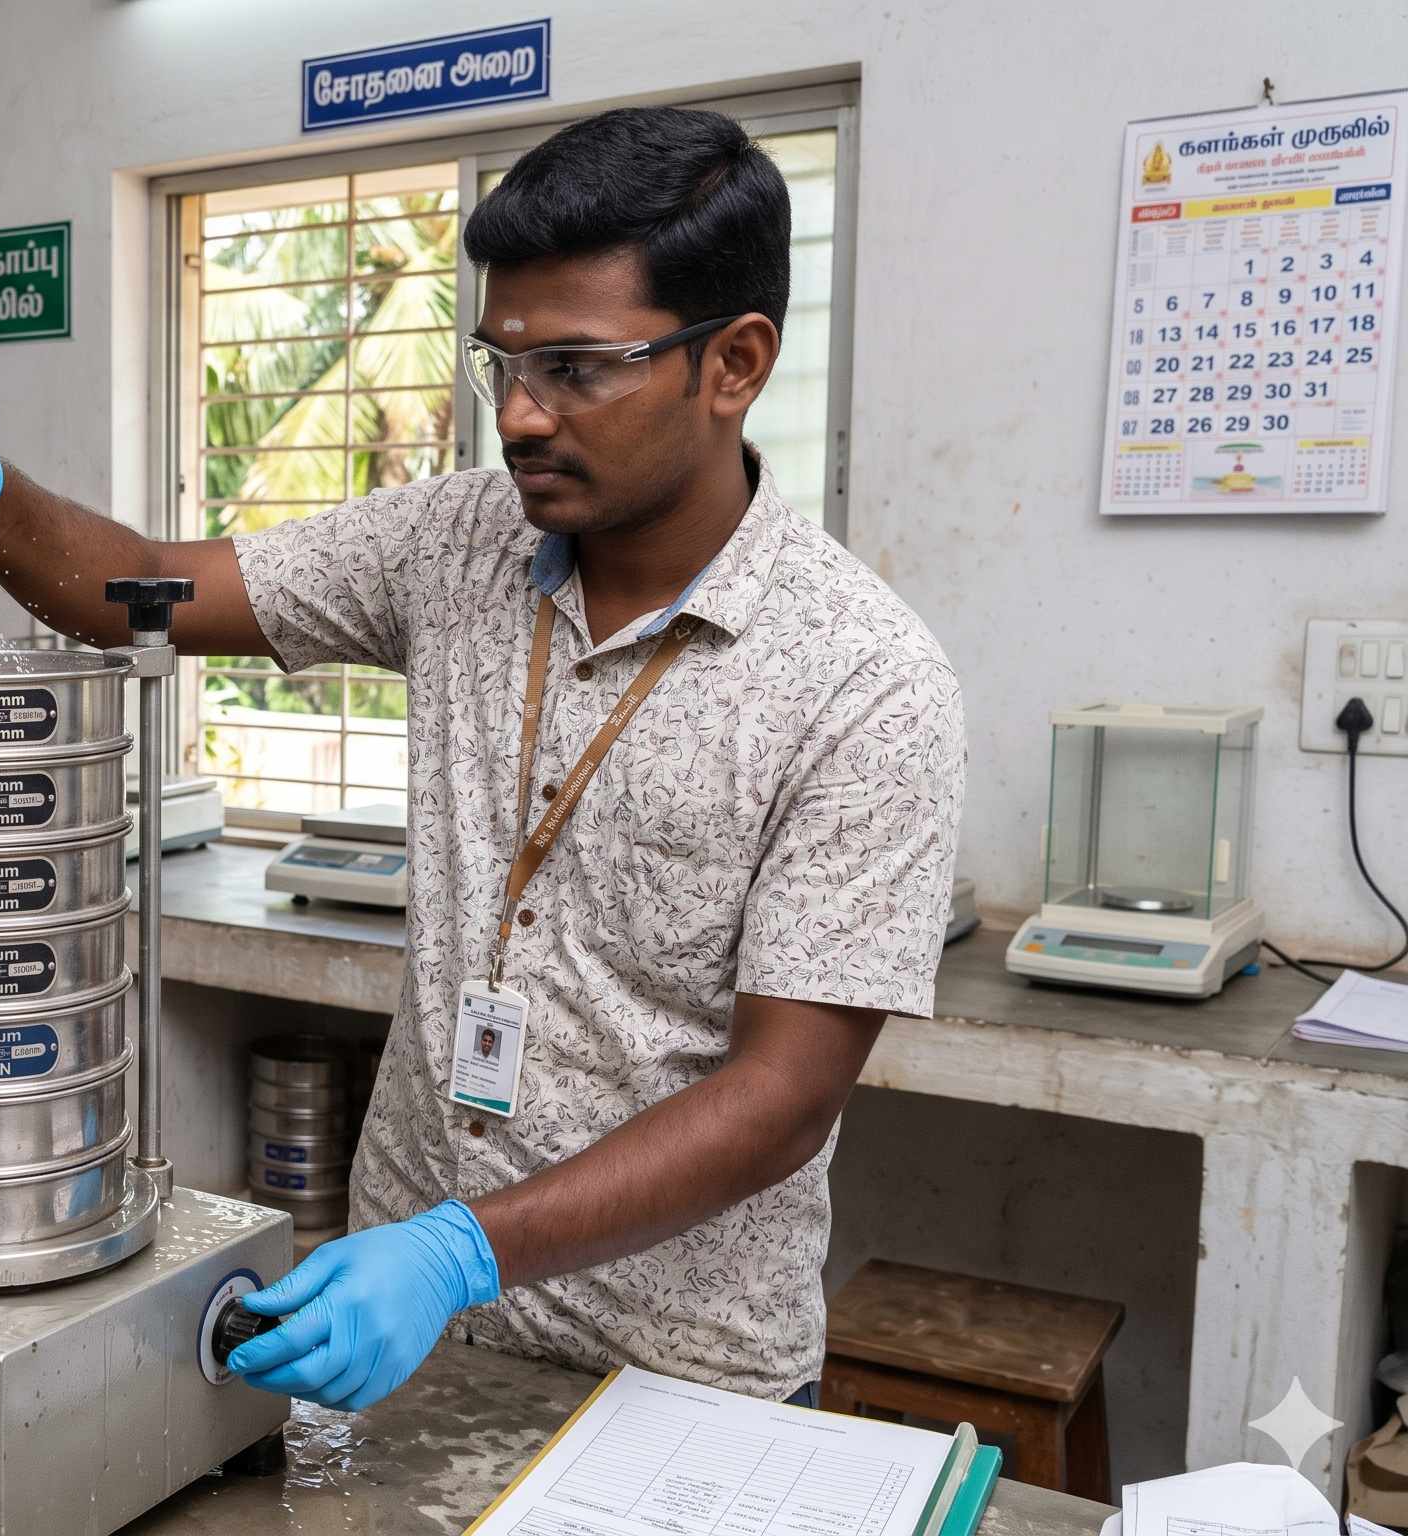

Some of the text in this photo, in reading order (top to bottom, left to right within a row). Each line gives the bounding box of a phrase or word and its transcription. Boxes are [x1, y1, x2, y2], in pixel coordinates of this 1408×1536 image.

[313, 45, 536, 110] சோதனை அறை
[1244, 249, 1374, 275] 1 2 3 4
[1165, 295, 1179, 312] 6
[1203, 292, 1216, 309] 7
[1240, 290, 1253, 307] 8
[1278, 288, 1292, 305] 9
[1311, 284, 1337, 302] 10
[1351, 282, 1375, 300] 11
[1158, 326, 1182, 343] 13
[1195, 325, 1219, 341] 14
[1233, 322, 1257, 339] 15
[1271, 319, 1297, 337] 16
[1309, 316, 1336, 334] 17
[1348, 314, 1375, 332] 18
[1154, 356, 1180, 373] 20
[1191, 355, 1215, 372] 21
[1228, 353, 1255, 370] 22
[1267, 351, 1294, 368] 23
[1305, 349, 1333, 366] 24
[1345, 346, 1373, 364] 25
[1152, 387, 1178, 404] 27
[1188, 386, 1215, 403] 28
[1226, 384, 1253, 401] 29
[1264, 382, 1292, 400] 30
[1304, 380, 1329, 398] 31
[1224, 415, 1251, 432] 29
[1262, 414, 1290, 431] 30
